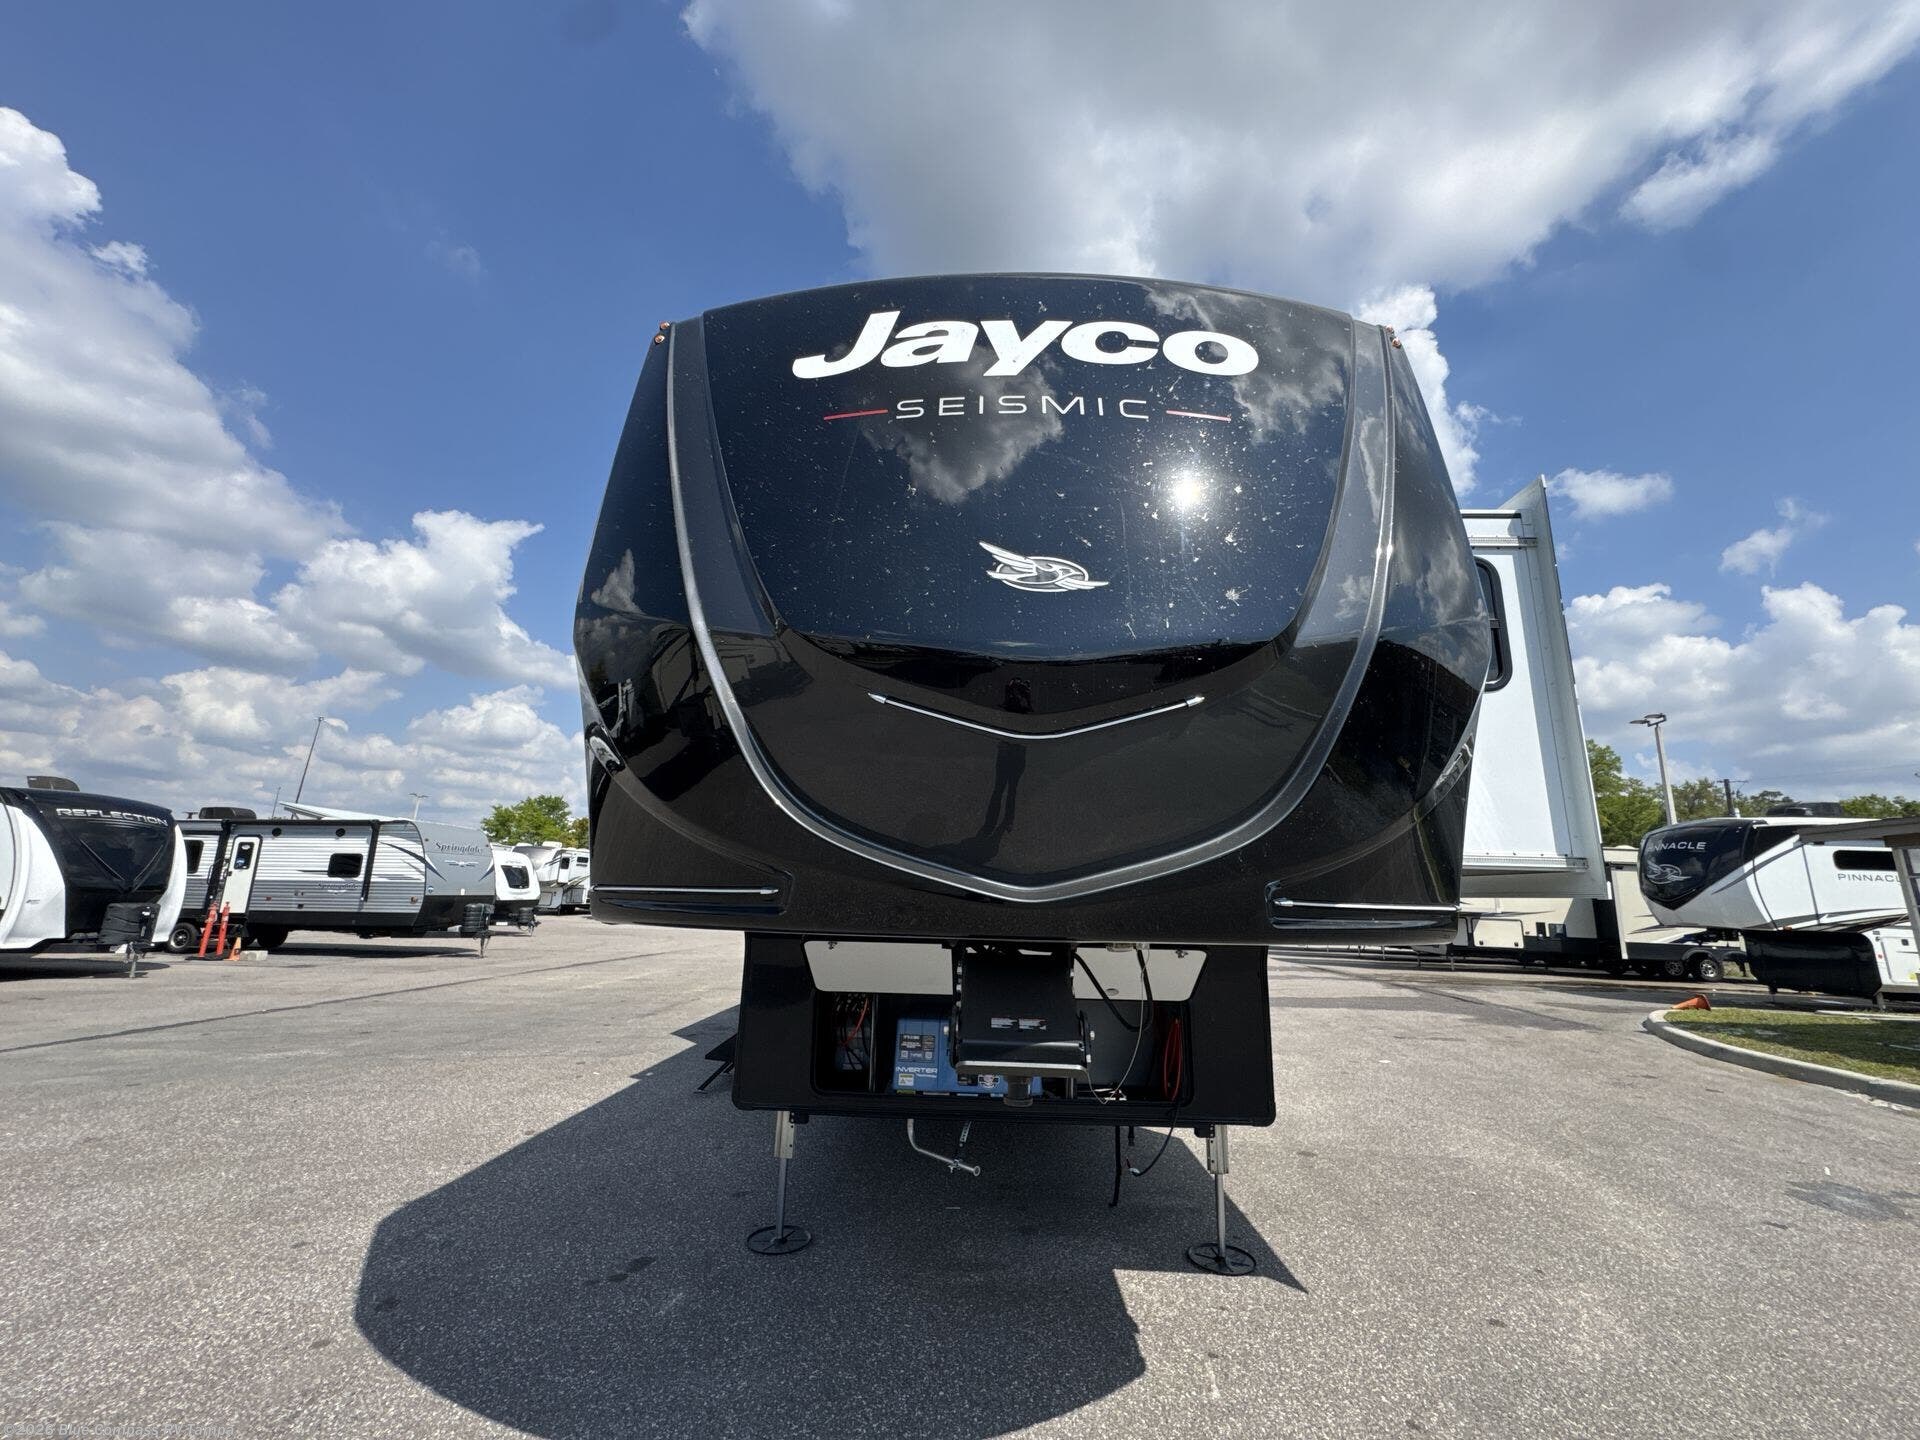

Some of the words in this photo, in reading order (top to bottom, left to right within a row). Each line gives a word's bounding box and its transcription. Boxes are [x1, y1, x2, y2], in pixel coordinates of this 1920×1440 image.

[792, 310, 1260, 379] Jayco
[895, 394, 1150, 420] SEISMIC
[56, 807, 169, 827] REFLECTION
[1647, 841, 1707, 851] NNACLE
[895, 1066, 938, 1074] INVERTER
